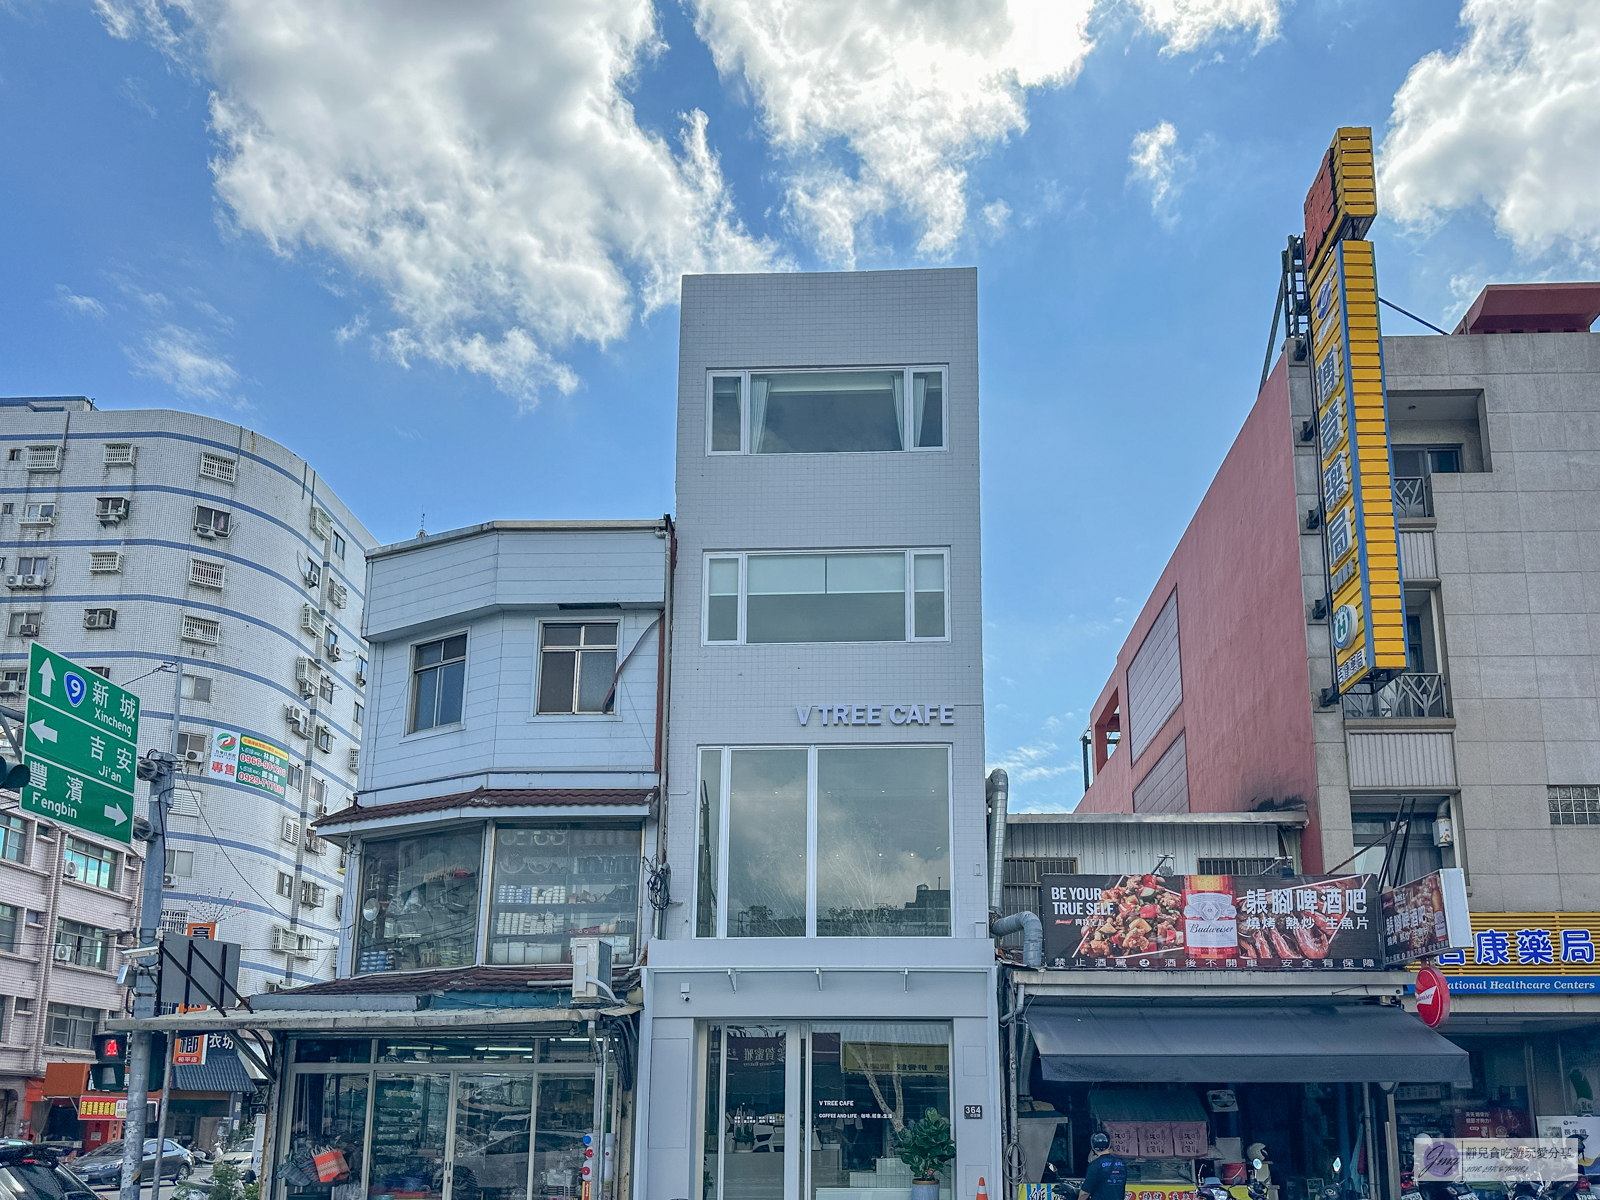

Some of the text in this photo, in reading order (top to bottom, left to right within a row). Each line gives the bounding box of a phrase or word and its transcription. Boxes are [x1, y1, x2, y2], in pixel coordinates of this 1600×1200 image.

[70, 679, 81, 698] 9
[92, 680, 136, 722] 新城
[94, 707, 133, 738] Xincheng
[795, 704, 955, 727] V TREE CAFE
[90, 735, 133, 774] 吉安
[29, 760, 84, 804] 豐濱
[98, 765, 122, 784] Ji'an
[32, 792, 78, 819] Fengbin
[1051, 887, 1102, 901] BE YOUR
[1052, 901, 1114, 916] TRUE SELF
[1189, 923, 1234, 934] Budweiser
[1246, 916, 1369, 930] 燒烤 熱炒 生魚片
[1054, 958, 1375, 968] 禁止酒駕 酒後不開車 安全有保障
[1447, 979, 1596, 991] ational Healthcare Centers
[965, 1106, 981, 1114] 364
